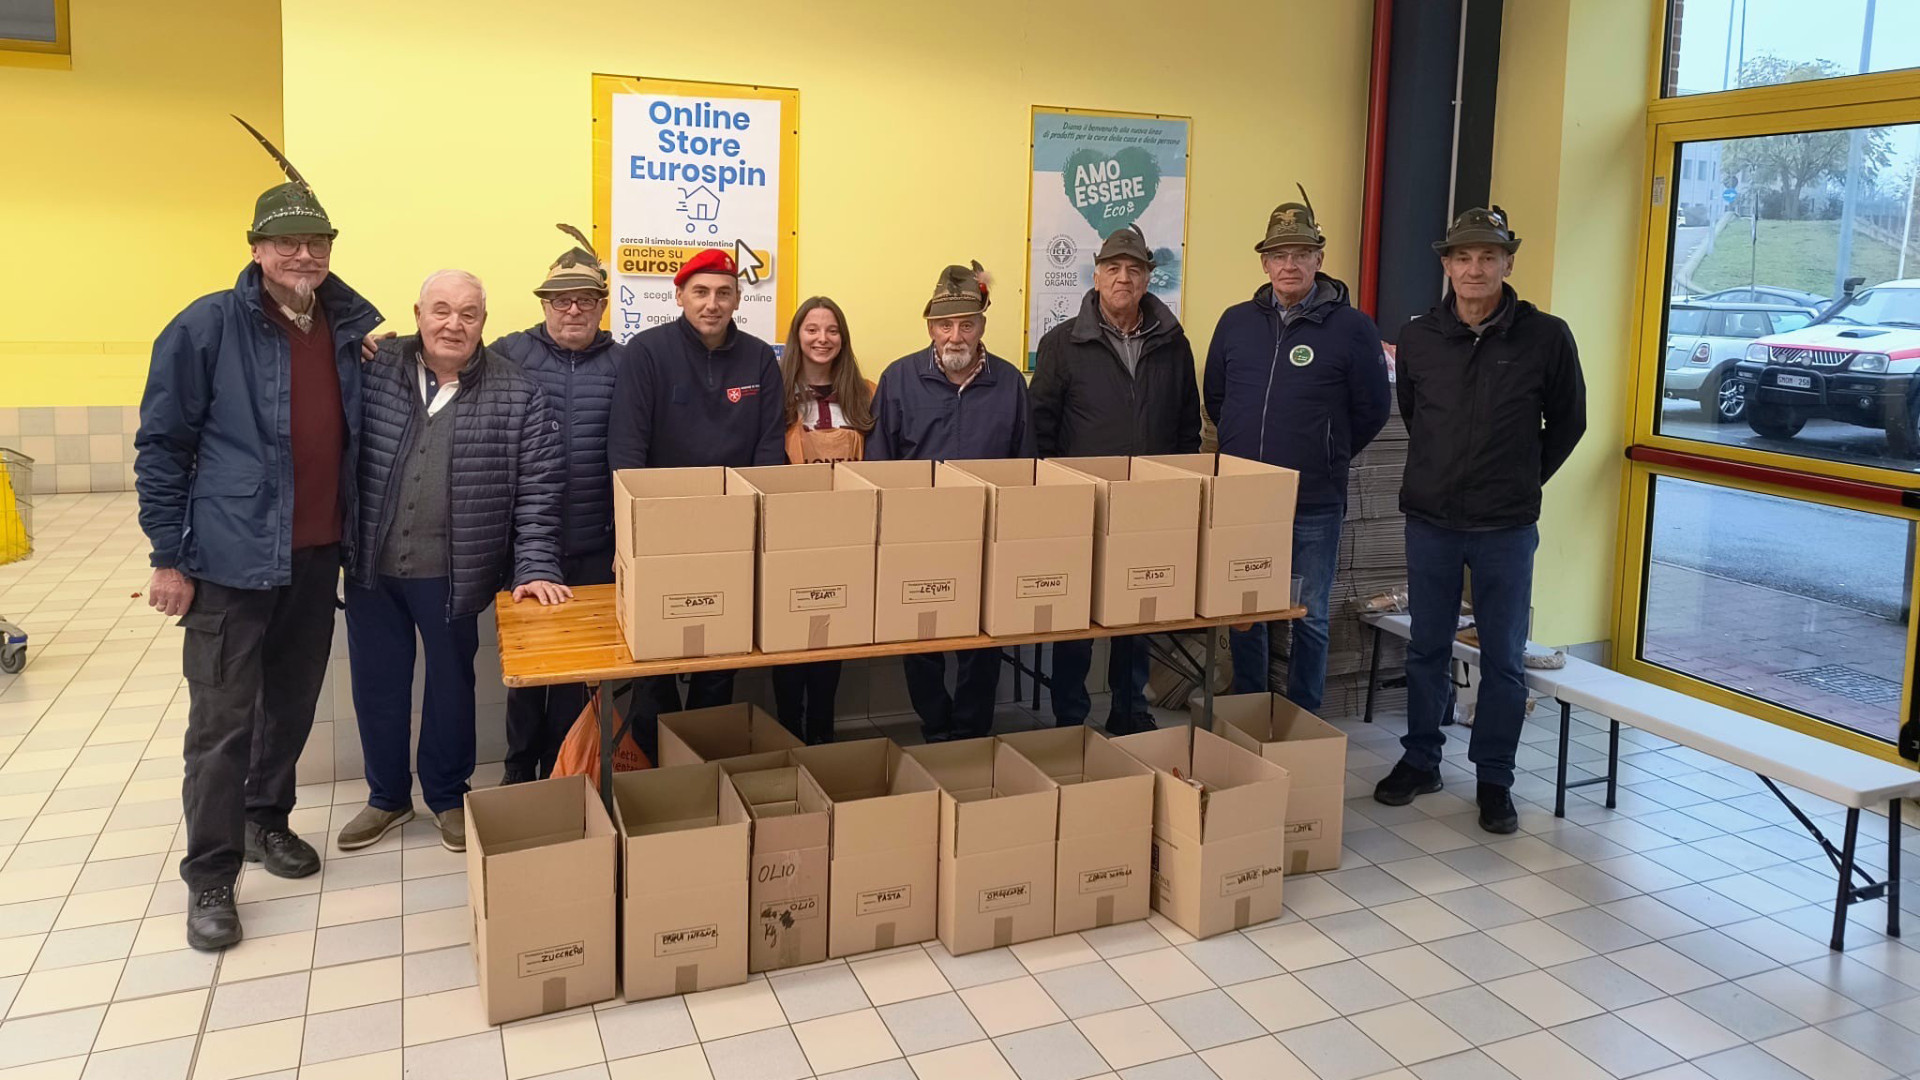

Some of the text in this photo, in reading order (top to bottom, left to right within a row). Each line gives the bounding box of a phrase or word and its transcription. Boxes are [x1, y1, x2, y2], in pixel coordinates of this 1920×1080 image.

[649, 101, 750, 130] Online
[1050, 131, 1075, 140] prodotti
[658, 129, 741, 157] Store
[630, 155, 766, 192] Eurospin
[1075, 160, 1120, 187] AMO
[1075, 176, 1145, 208] ESSERE
[1103, 203, 1126, 218] Eco
[651, 237, 683, 246] simbolo
[696, 239, 734, 247] volantino
[623, 247, 683, 259] anche su
[1045, 279, 1077, 287] ORGANIC
[644, 291, 672, 302] scegli
[744, 293, 772, 302] online
[1145, 571, 1164, 580] RISO
[920, 584, 951, 595] LEGUMI
[1035, 580, 1061, 589] TONNO
[810, 591, 836, 600] PELATI
[685, 597, 714, 607] PASTA
[758, 863, 795, 883] OLIO
[877, 892, 902, 903] PASTA
[790, 901, 815, 911] OLIO
